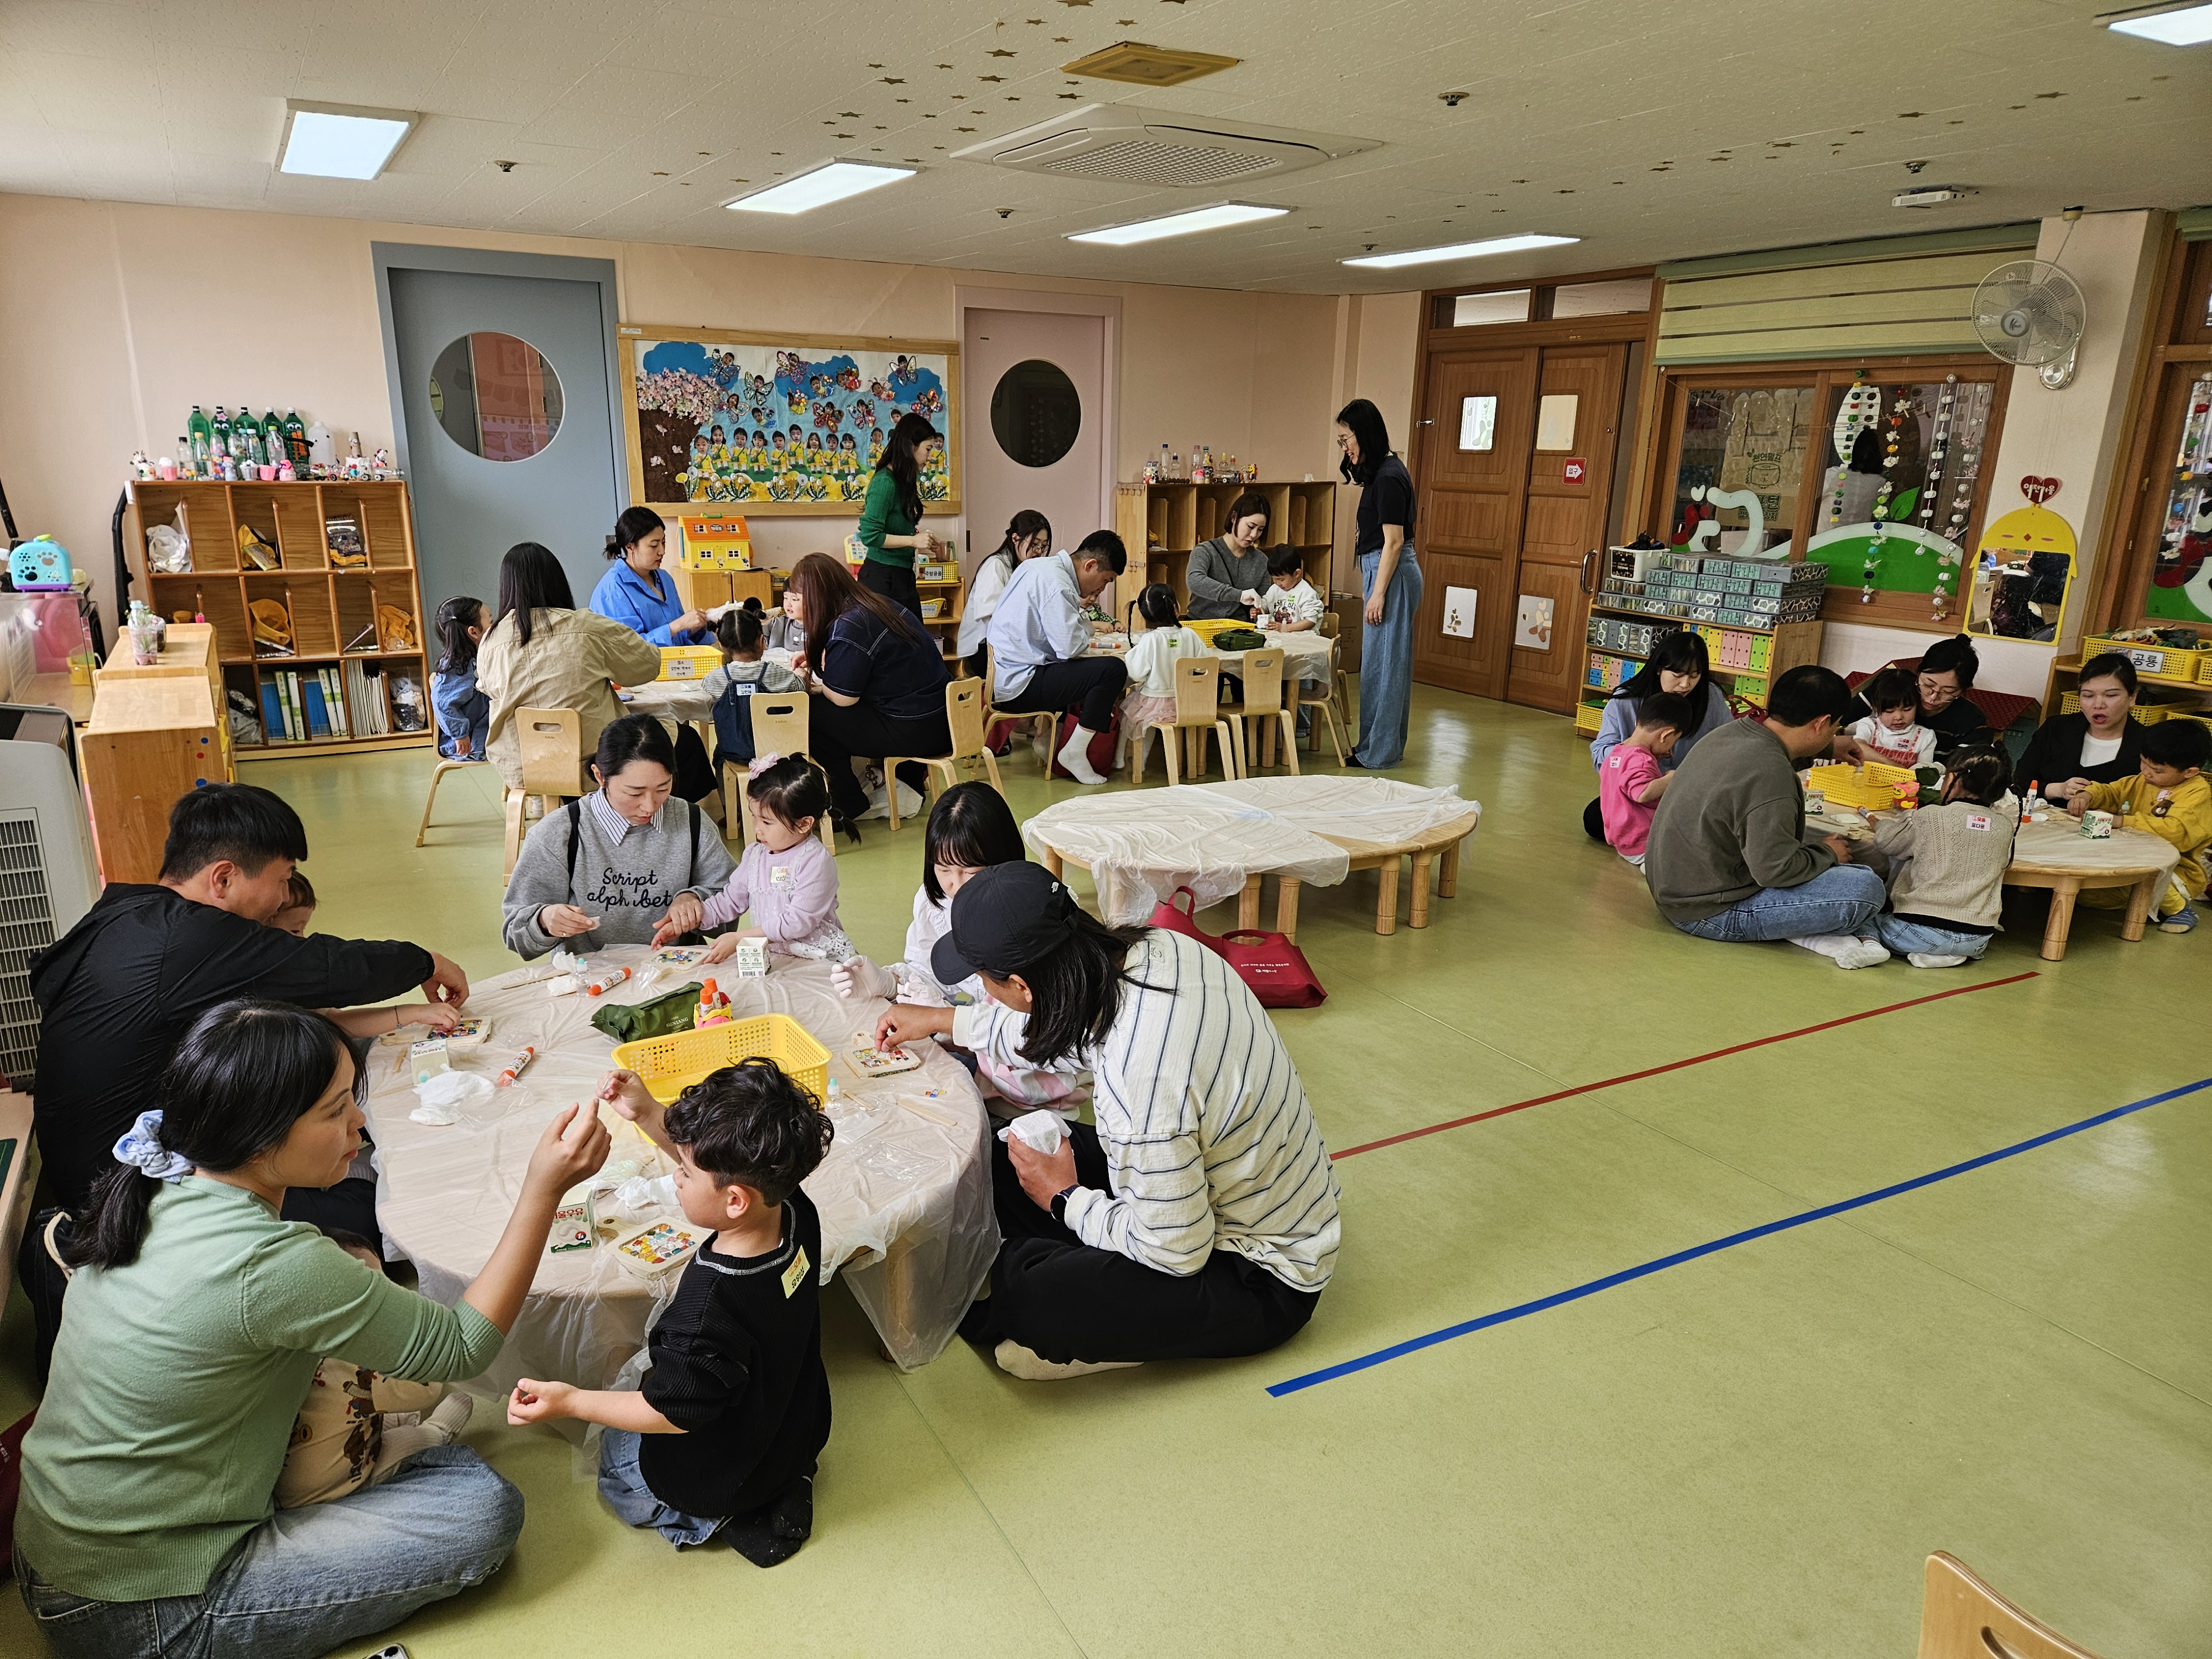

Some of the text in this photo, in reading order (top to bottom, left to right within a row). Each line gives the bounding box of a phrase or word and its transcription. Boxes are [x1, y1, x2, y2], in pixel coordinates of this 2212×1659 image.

[2132, 653, 2158, 667] 공룡
[602, 867, 658, 893] Script
[554, 1208, 583, 1219] 울우유
